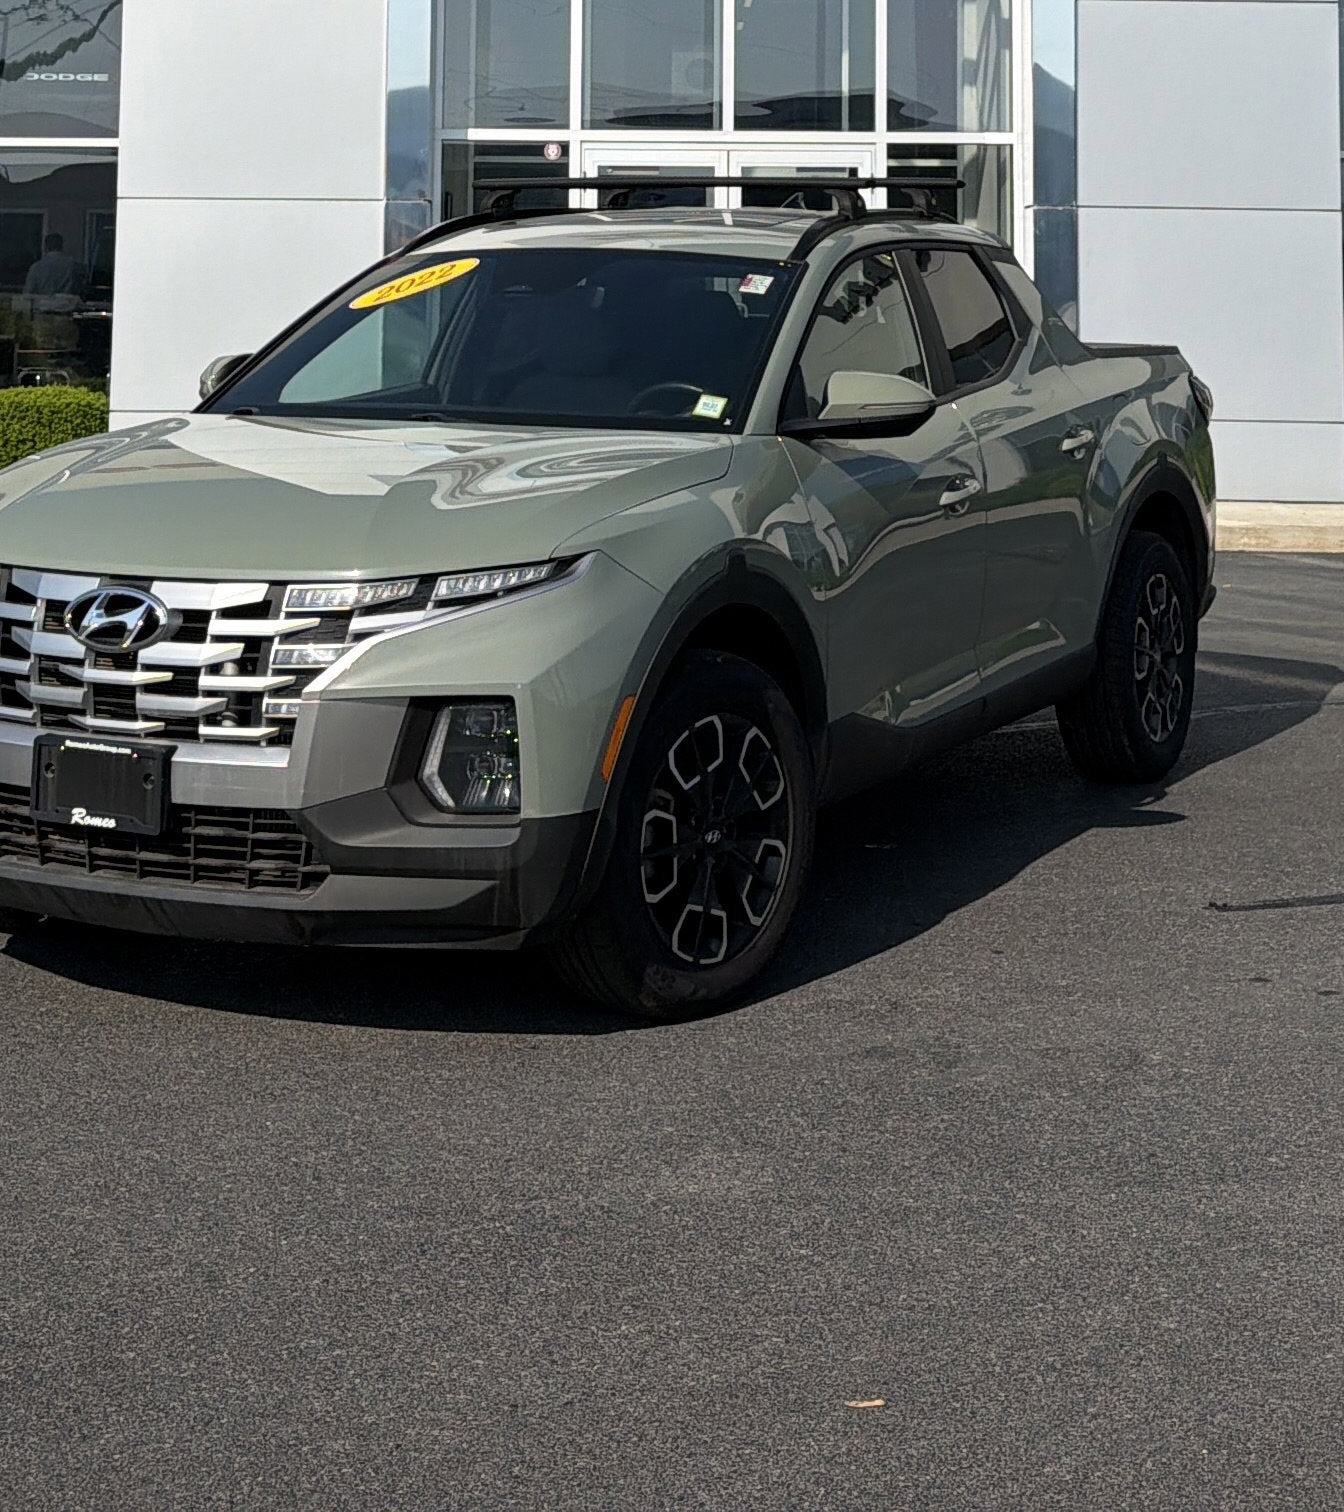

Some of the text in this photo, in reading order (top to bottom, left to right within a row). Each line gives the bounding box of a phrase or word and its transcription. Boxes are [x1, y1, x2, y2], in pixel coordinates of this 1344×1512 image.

[24, 72, 110, 82] DODGE
[374, 263, 457, 302] 2022
[70, 807, 117, 829] Romeo
